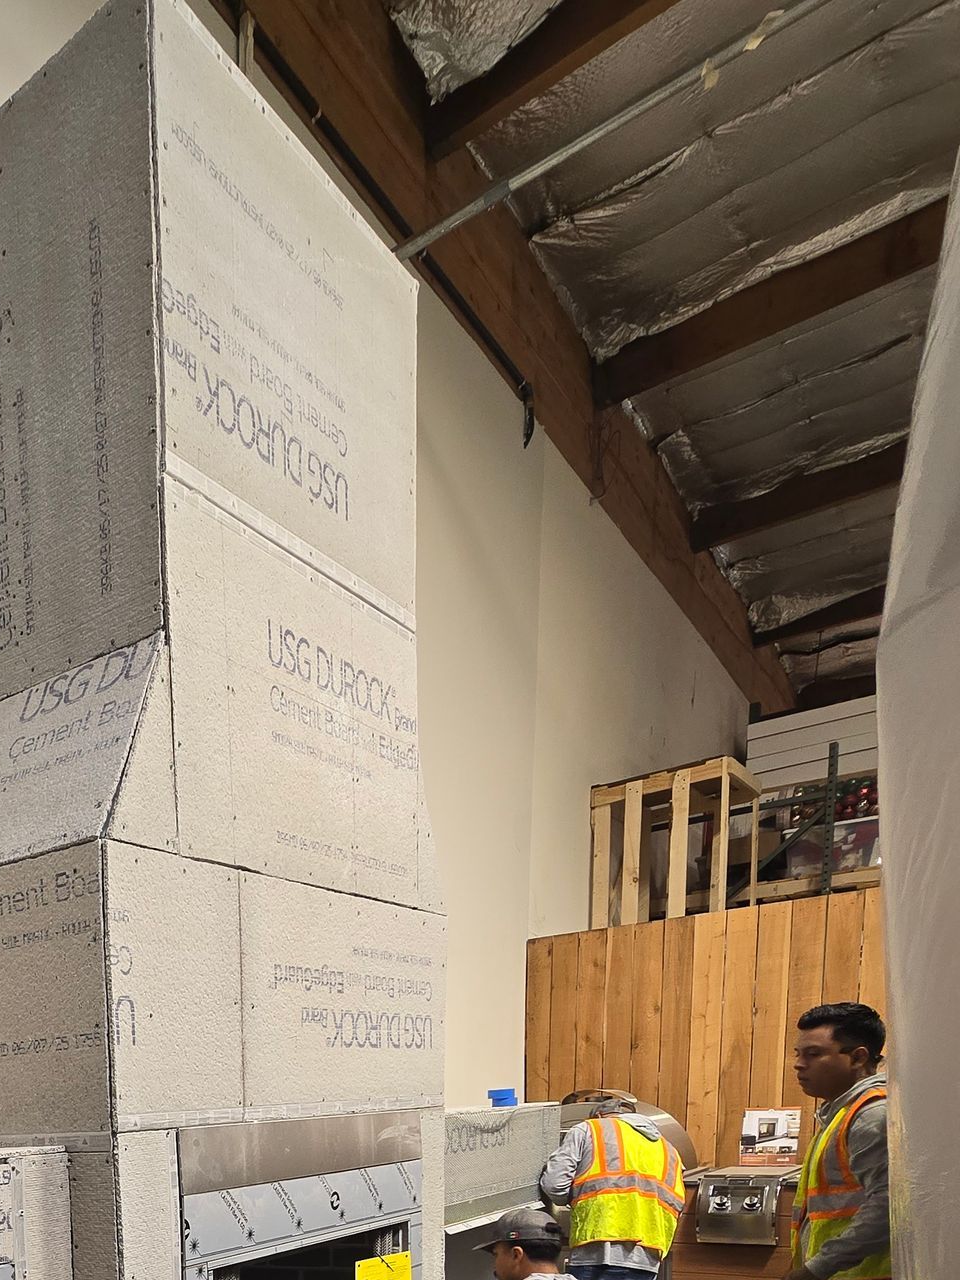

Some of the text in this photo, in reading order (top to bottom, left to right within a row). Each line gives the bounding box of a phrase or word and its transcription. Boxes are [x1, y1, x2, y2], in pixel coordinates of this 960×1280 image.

[250, 355, 294, 416] Board
[299, 400, 348, 457] Cement
[307, 450, 349, 522] USG
[267, 619, 312, 682] USG
[19, 664, 94, 723] USG
[270, 685, 322, 731] Cement
[9, 710, 92, 759] Cement
[365, 974, 394, 999] Board
[398, 977, 433, 1002] Cement
[301, 1007, 328, 1029] Brand
[404, 1014, 433, 1049] USG
